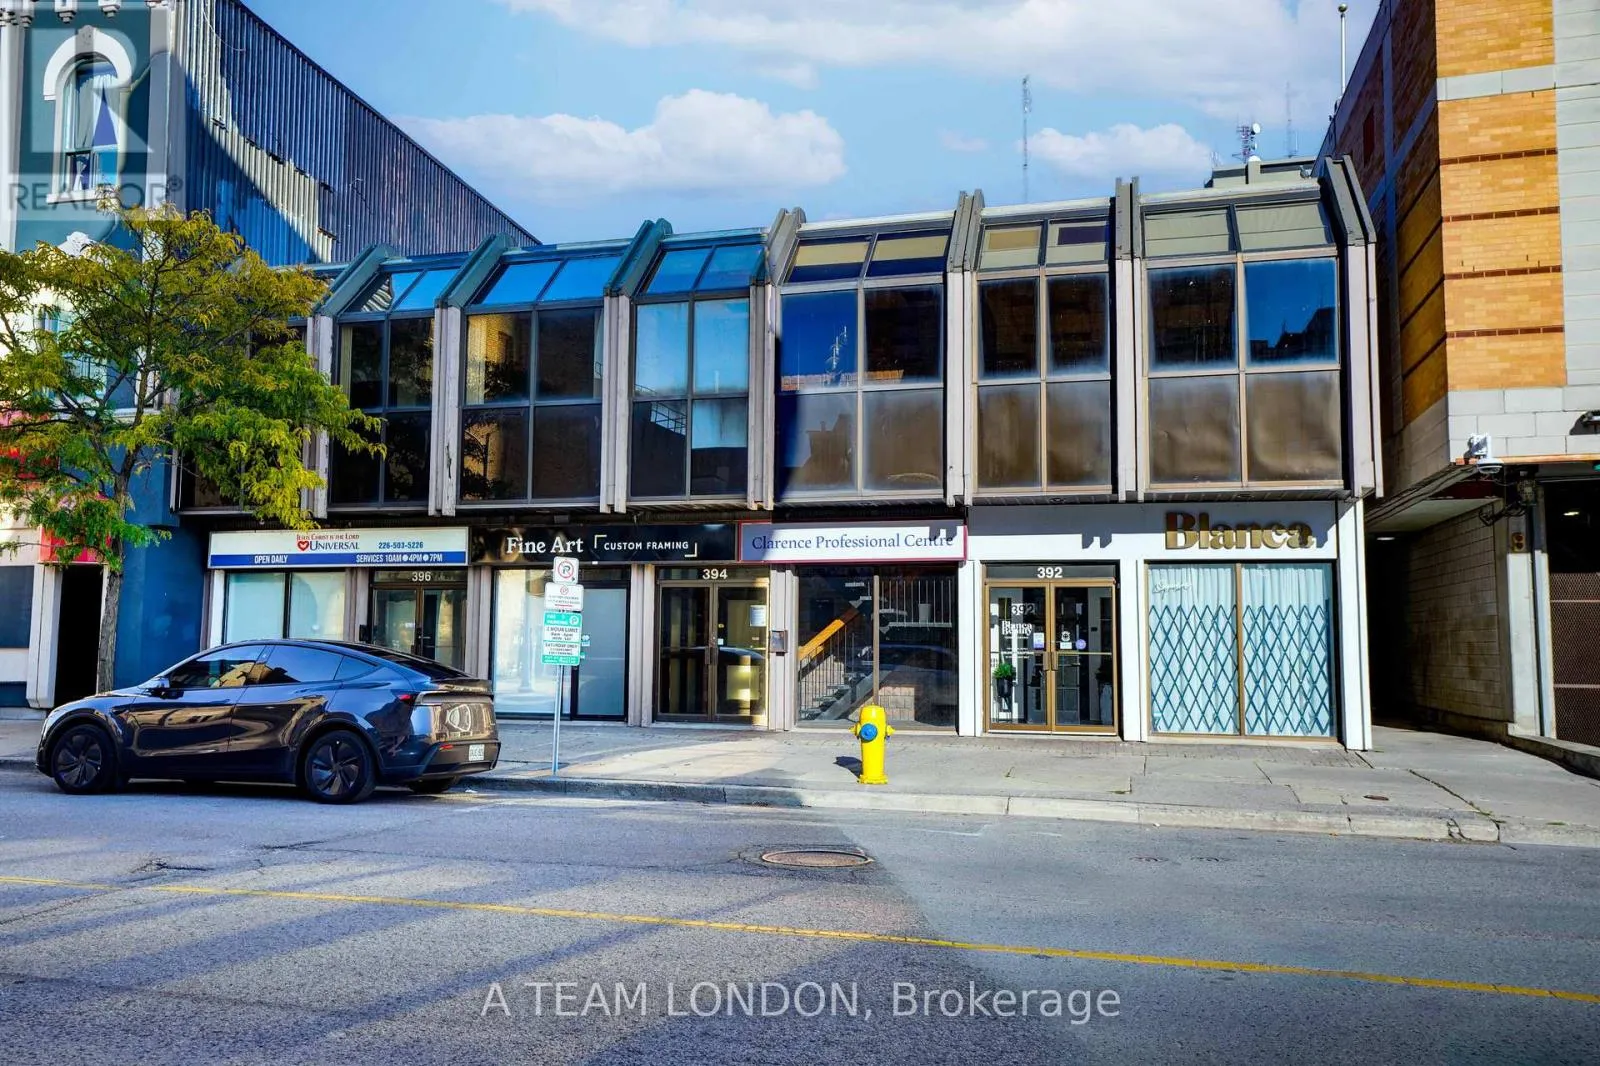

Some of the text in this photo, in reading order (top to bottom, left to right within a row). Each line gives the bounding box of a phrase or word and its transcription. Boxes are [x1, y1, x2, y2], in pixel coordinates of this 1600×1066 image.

[1165, 512, 1314, 549] Blanca
[310, 540, 360, 551] UNIVERSAL
[378, 541, 424, 549] 226-503-5226
[507, 536, 584, 553] Fine Art
[604, 541, 689, 550] CUSTOM FRAMING
[752, 534, 954, 549] Clarence Professional Centre
[254, 555, 289, 564] OPEN DAILY
[356, 554, 384, 563] SERVICES
[412, 571, 431, 582] 396
[703, 569, 728, 580] 394
[1037, 567, 1063, 578] 392
